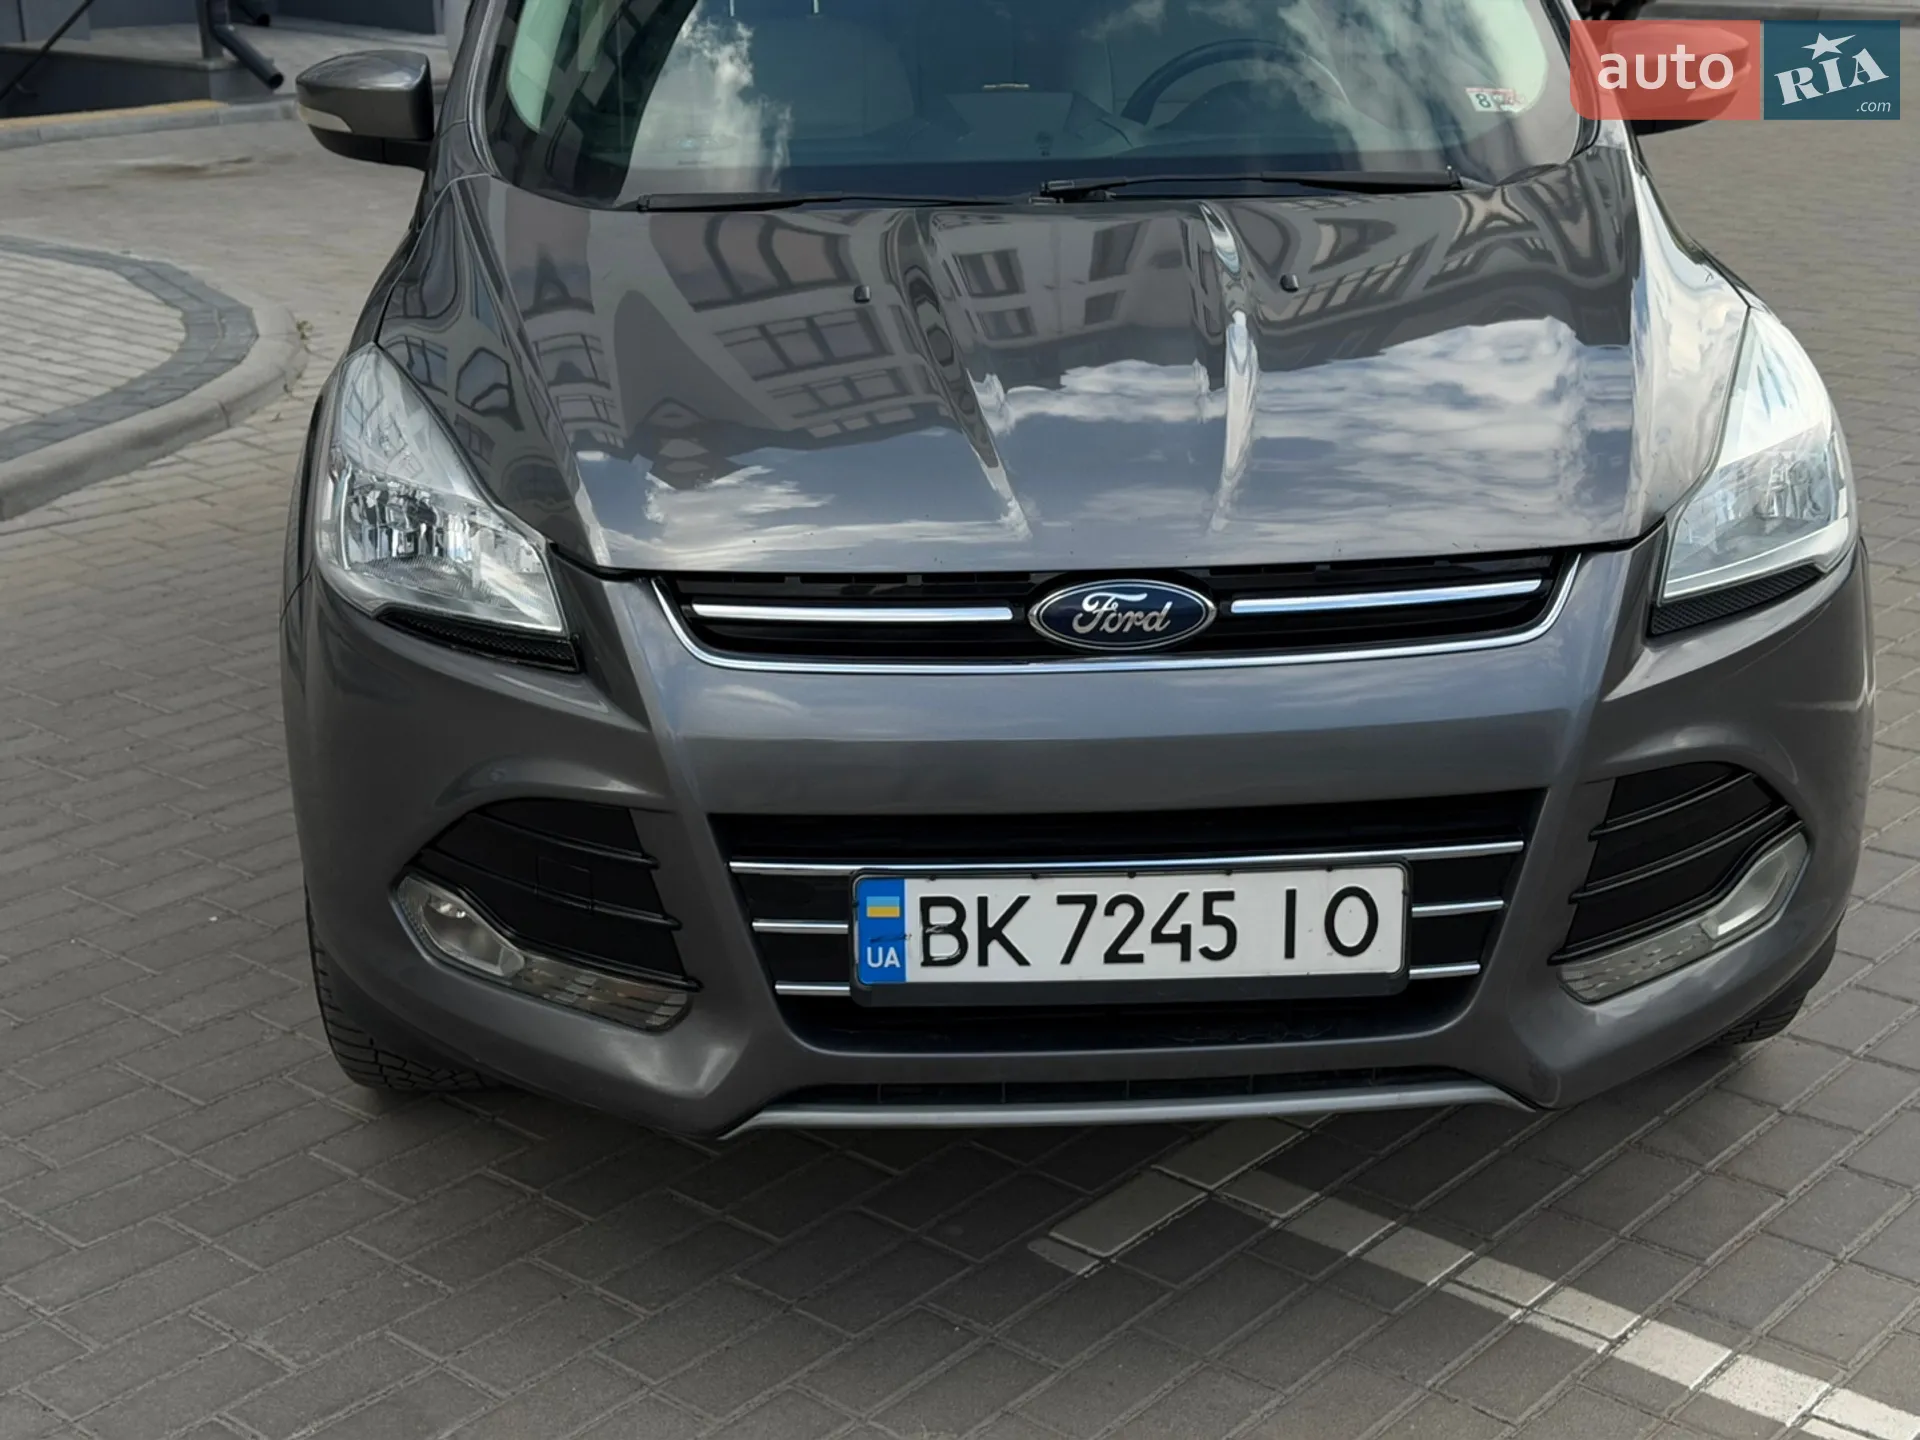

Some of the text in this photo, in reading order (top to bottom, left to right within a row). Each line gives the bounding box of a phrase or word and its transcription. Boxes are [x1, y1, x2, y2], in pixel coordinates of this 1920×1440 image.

[1072, 592, 1174, 634] Ford
[919, 894, 1032, 967] BK
[1056, 890, 1238, 965] 7245
[866, 945, 901, 968] UA
